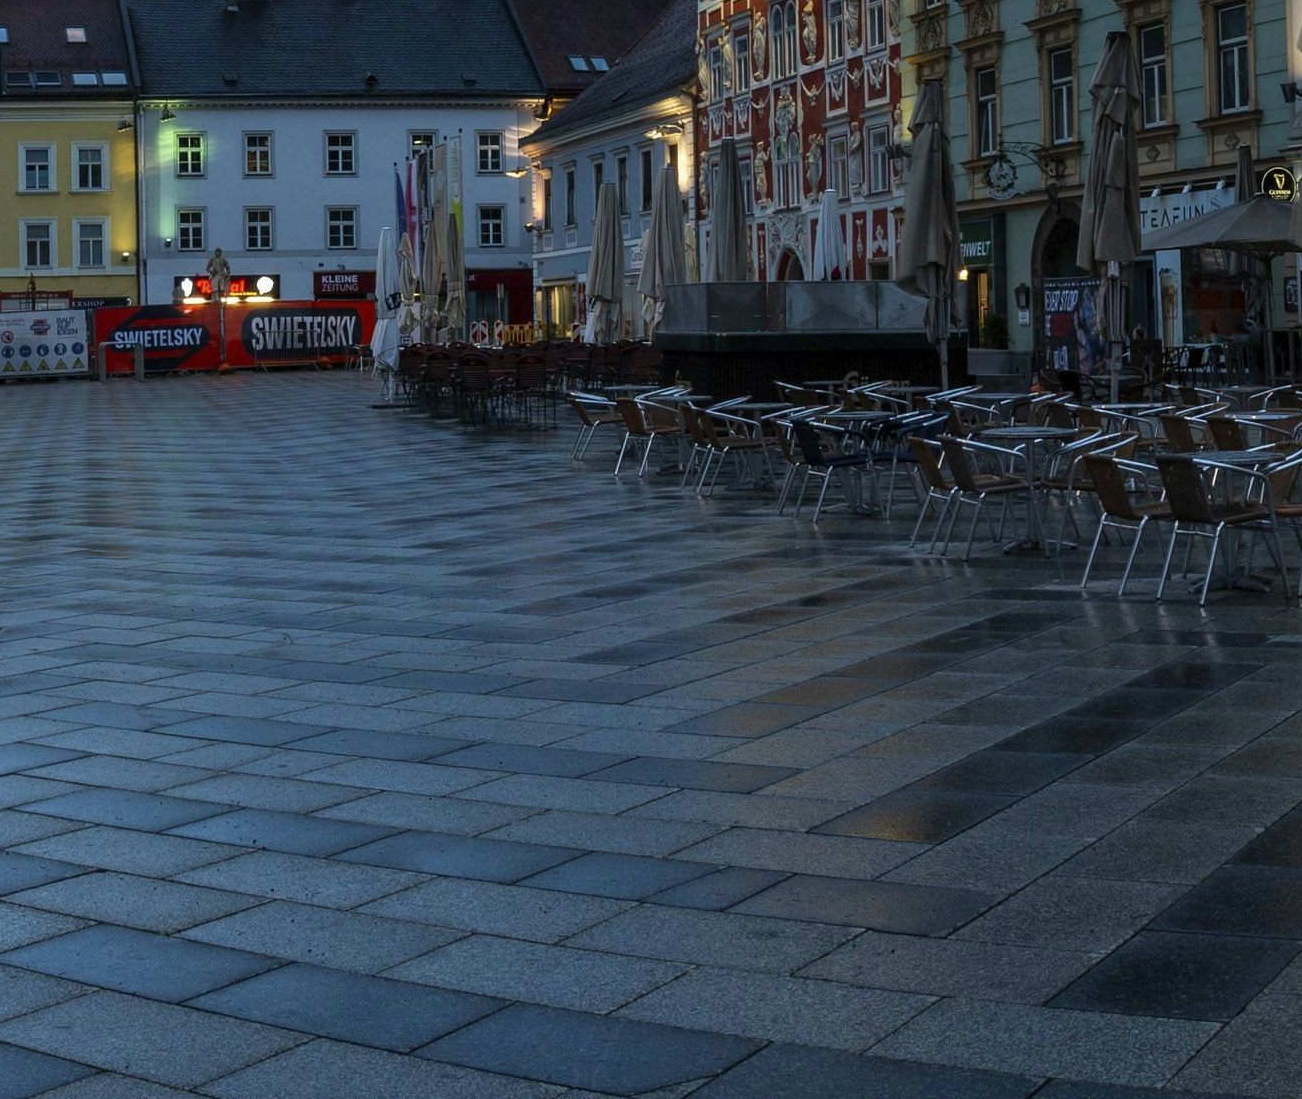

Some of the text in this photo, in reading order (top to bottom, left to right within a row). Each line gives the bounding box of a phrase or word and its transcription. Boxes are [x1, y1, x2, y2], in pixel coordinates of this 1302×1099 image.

[1140, 204, 1204, 229] TEAFUN
[321, 275, 358, 284] KLEINE
[321, 284, 359, 293] ZEITUNG
[114, 327, 203, 349] SWIETELSKY
[251, 315, 356, 352] SWIETELSKY
